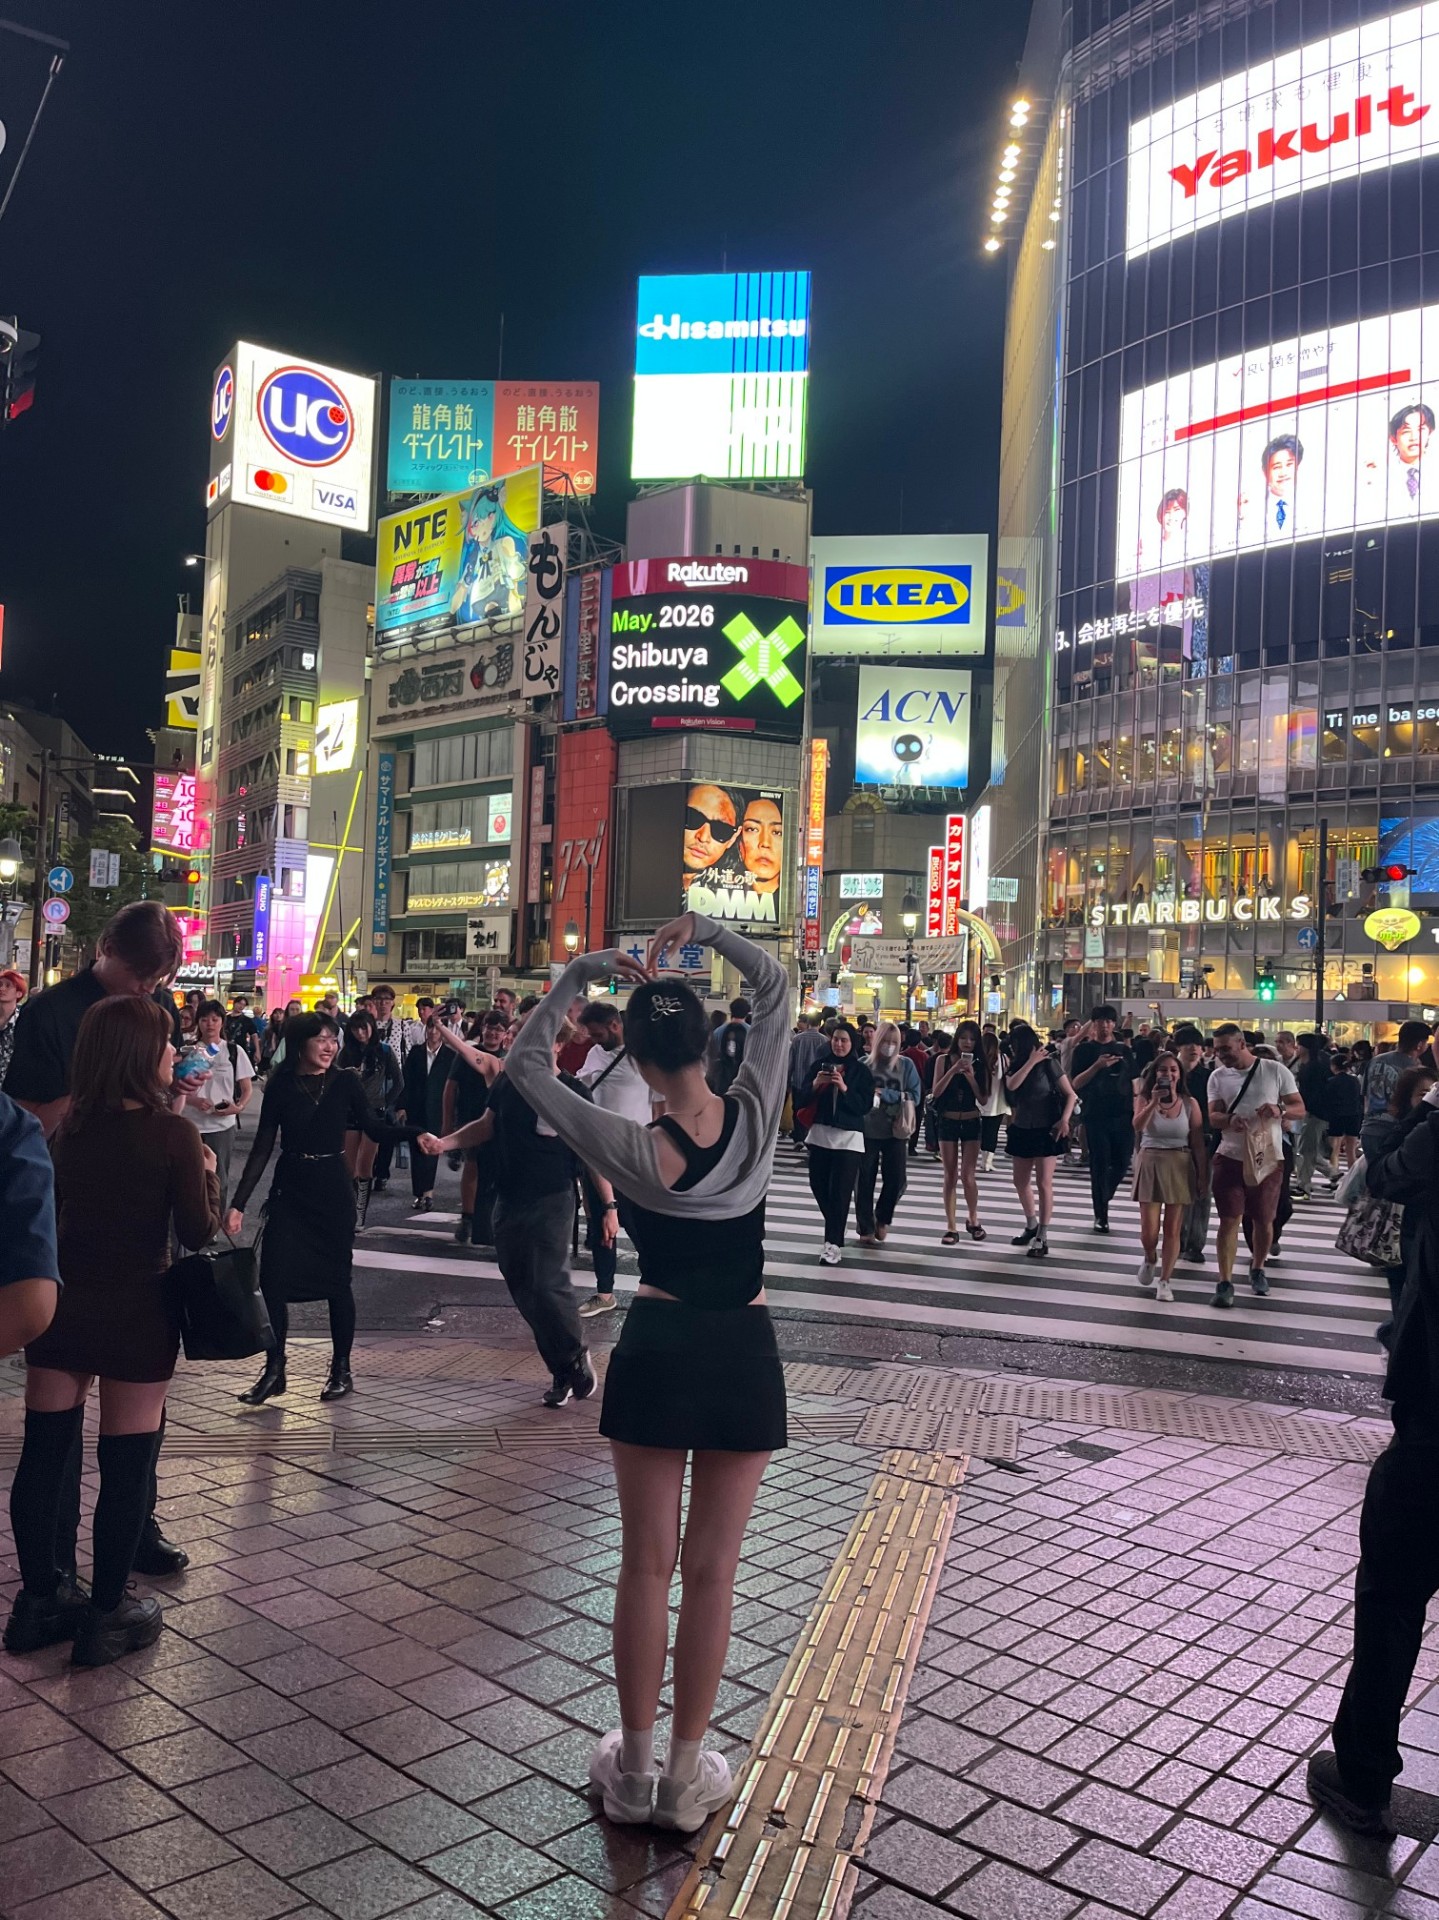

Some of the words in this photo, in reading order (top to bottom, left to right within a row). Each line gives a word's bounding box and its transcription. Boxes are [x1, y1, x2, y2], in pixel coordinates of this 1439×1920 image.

[1168, 84, 1431, 199] Yakult
[412, 403, 474, 431] 龍角散
[517, 404, 578, 433] 龍角散
[402, 433, 484, 460] ダイレクト
[507, 434, 589, 462] ダイレクト
[316, 488, 356, 511] VISA
[394, 508, 448, 553] NTE
[667, 562, 748, 587] Rakuten
[840, 583, 958, 606] IKEA
[524, 531, 563, 691] もんじゃ
[612, 642, 709, 670] Shibuya
[611, 678, 721, 707] Crossing
[860, 689, 968, 724] ACN
[680, 717, 706, 726] Rakuten
[706, 718, 726, 726] Vision
[377, 775, 391, 880] サマーフルーツギフト
[557, 819, 606, 902] クスリ
[946, 825, 963, 889] カラオケ
[707, 867, 758, 886] 外道の歌
[260, 884, 268, 912] MIZUHO
[688, 886, 776, 921] DMM
[843, 888, 882, 896] クリニック
[1090, 896, 1310, 926] STARBUCKS
[807, 928, 818, 949] 焼肉
